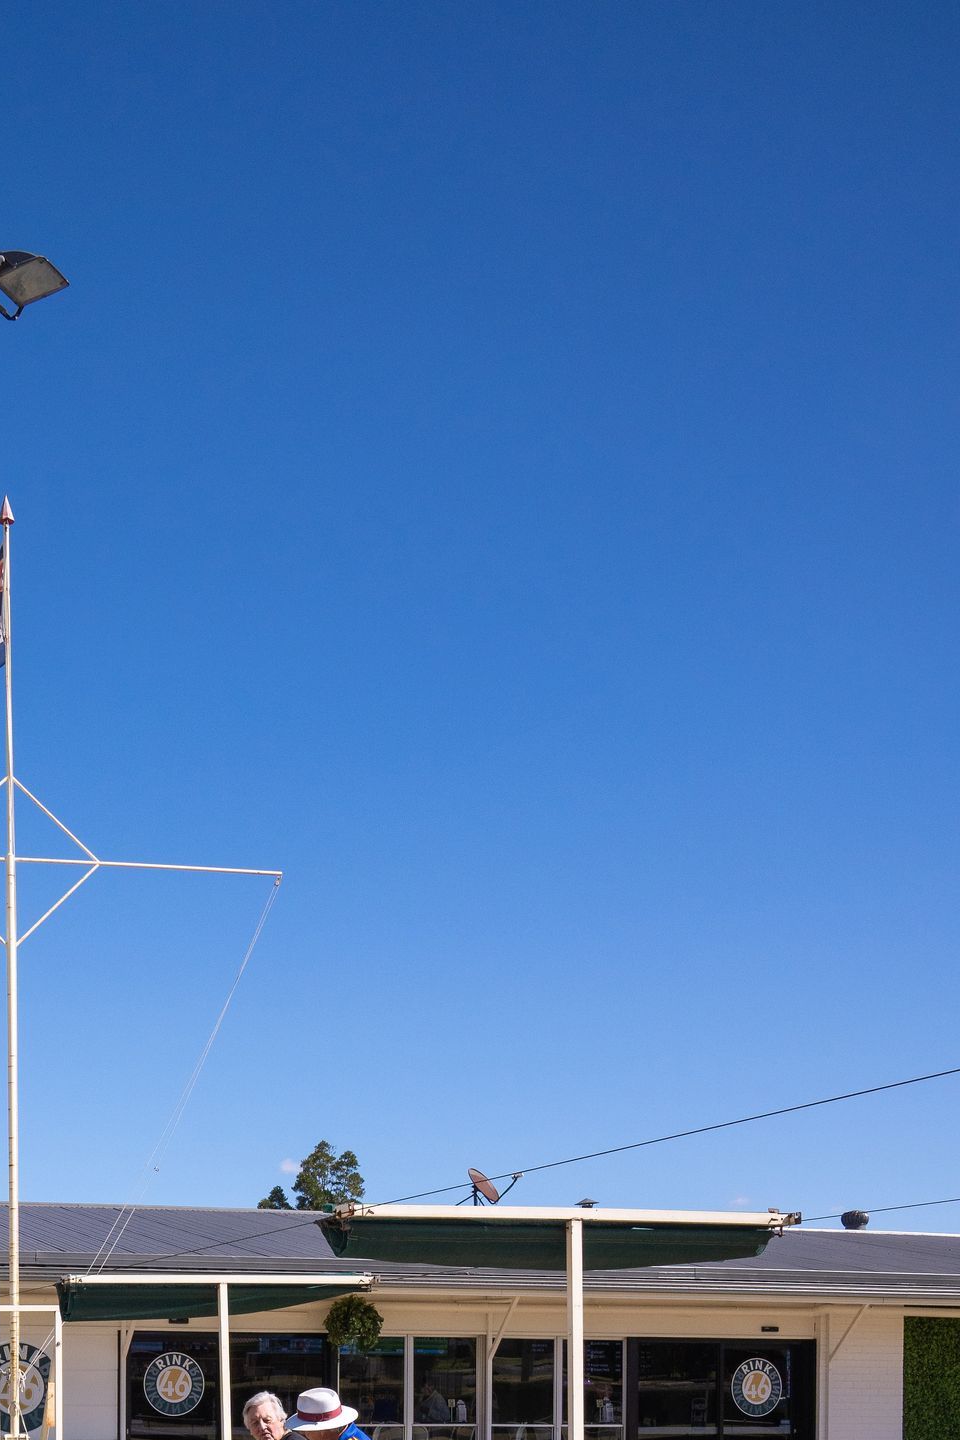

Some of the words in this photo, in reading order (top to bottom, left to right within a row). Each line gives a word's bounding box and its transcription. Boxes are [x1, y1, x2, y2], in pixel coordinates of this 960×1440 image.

[0, 1345, 49, 1367] INK
[155, 1354, 194, 1370] RINK
[741, 1360, 773, 1375] RINK
[159, 1371, 191, 1397] 46
[745, 1375, 770, 1399] 46
